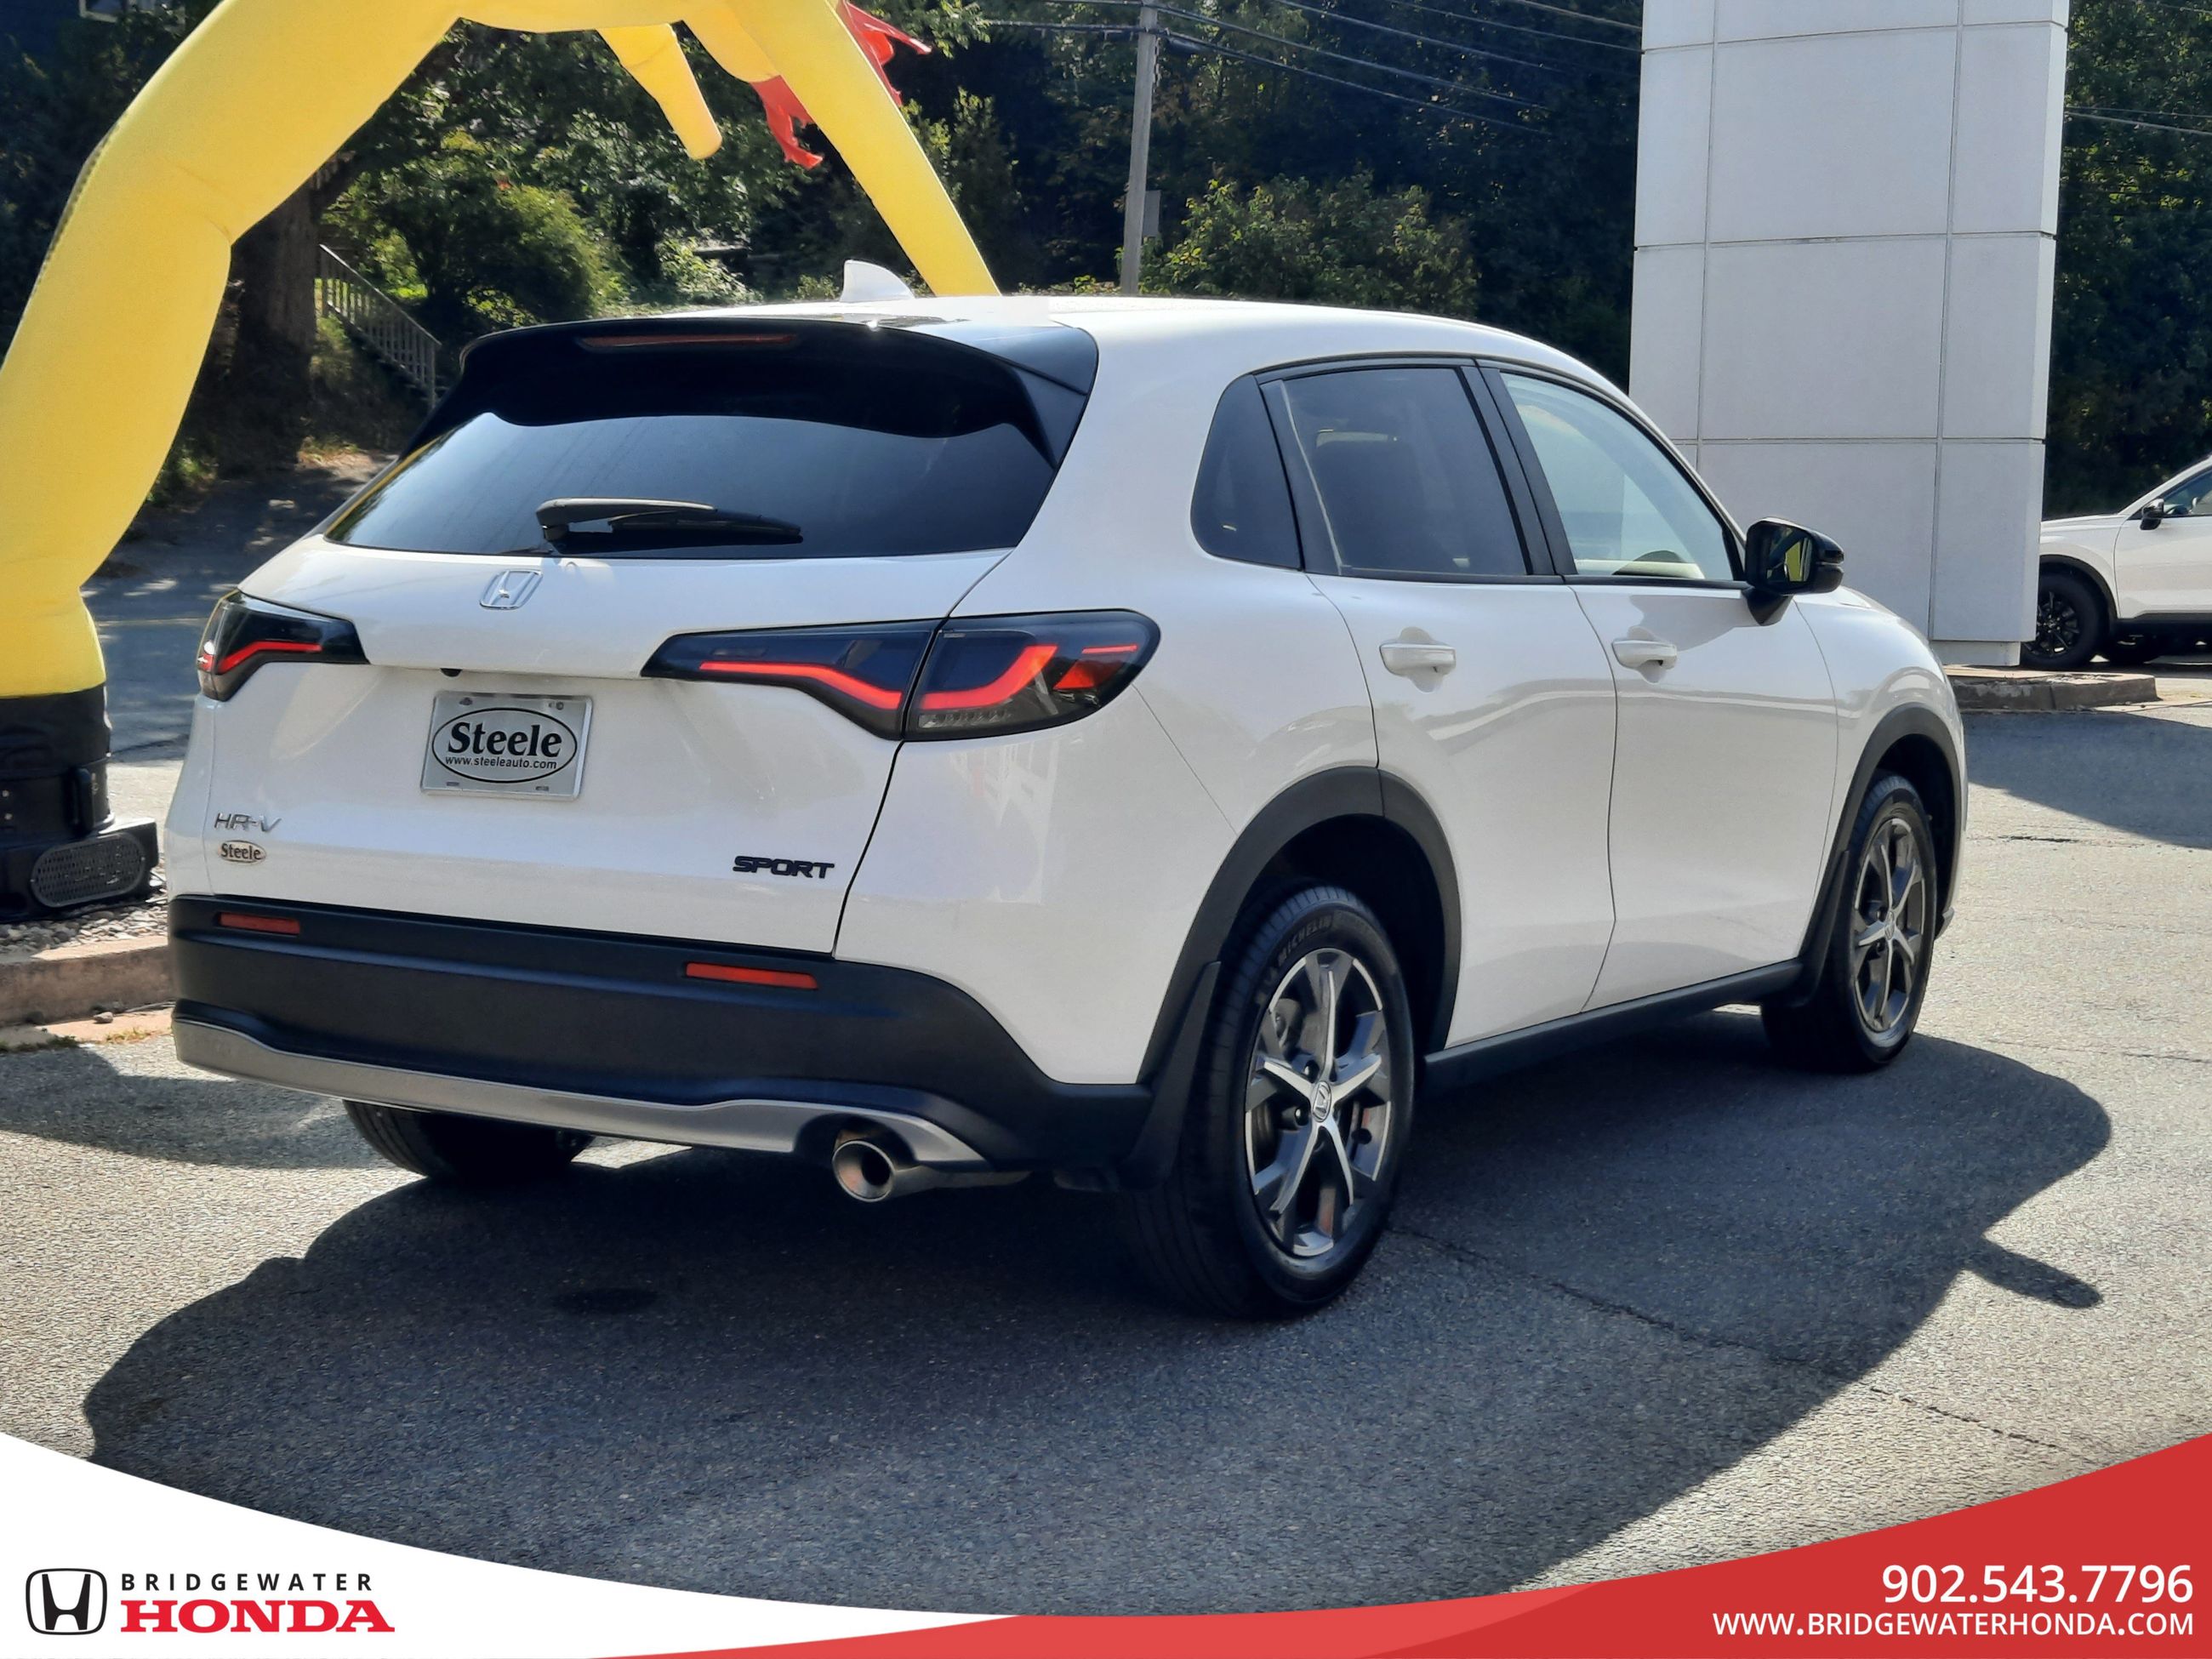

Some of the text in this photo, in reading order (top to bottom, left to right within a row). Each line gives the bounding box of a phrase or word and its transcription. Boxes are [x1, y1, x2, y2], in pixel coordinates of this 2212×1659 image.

[448, 721, 562, 758] Steele
[445, 755, 557, 769] www.steeleauto.com
[214, 812, 282, 833] HR-V
[220, 842, 262, 860] Steele
[733, 855, 835, 879] SPORT
